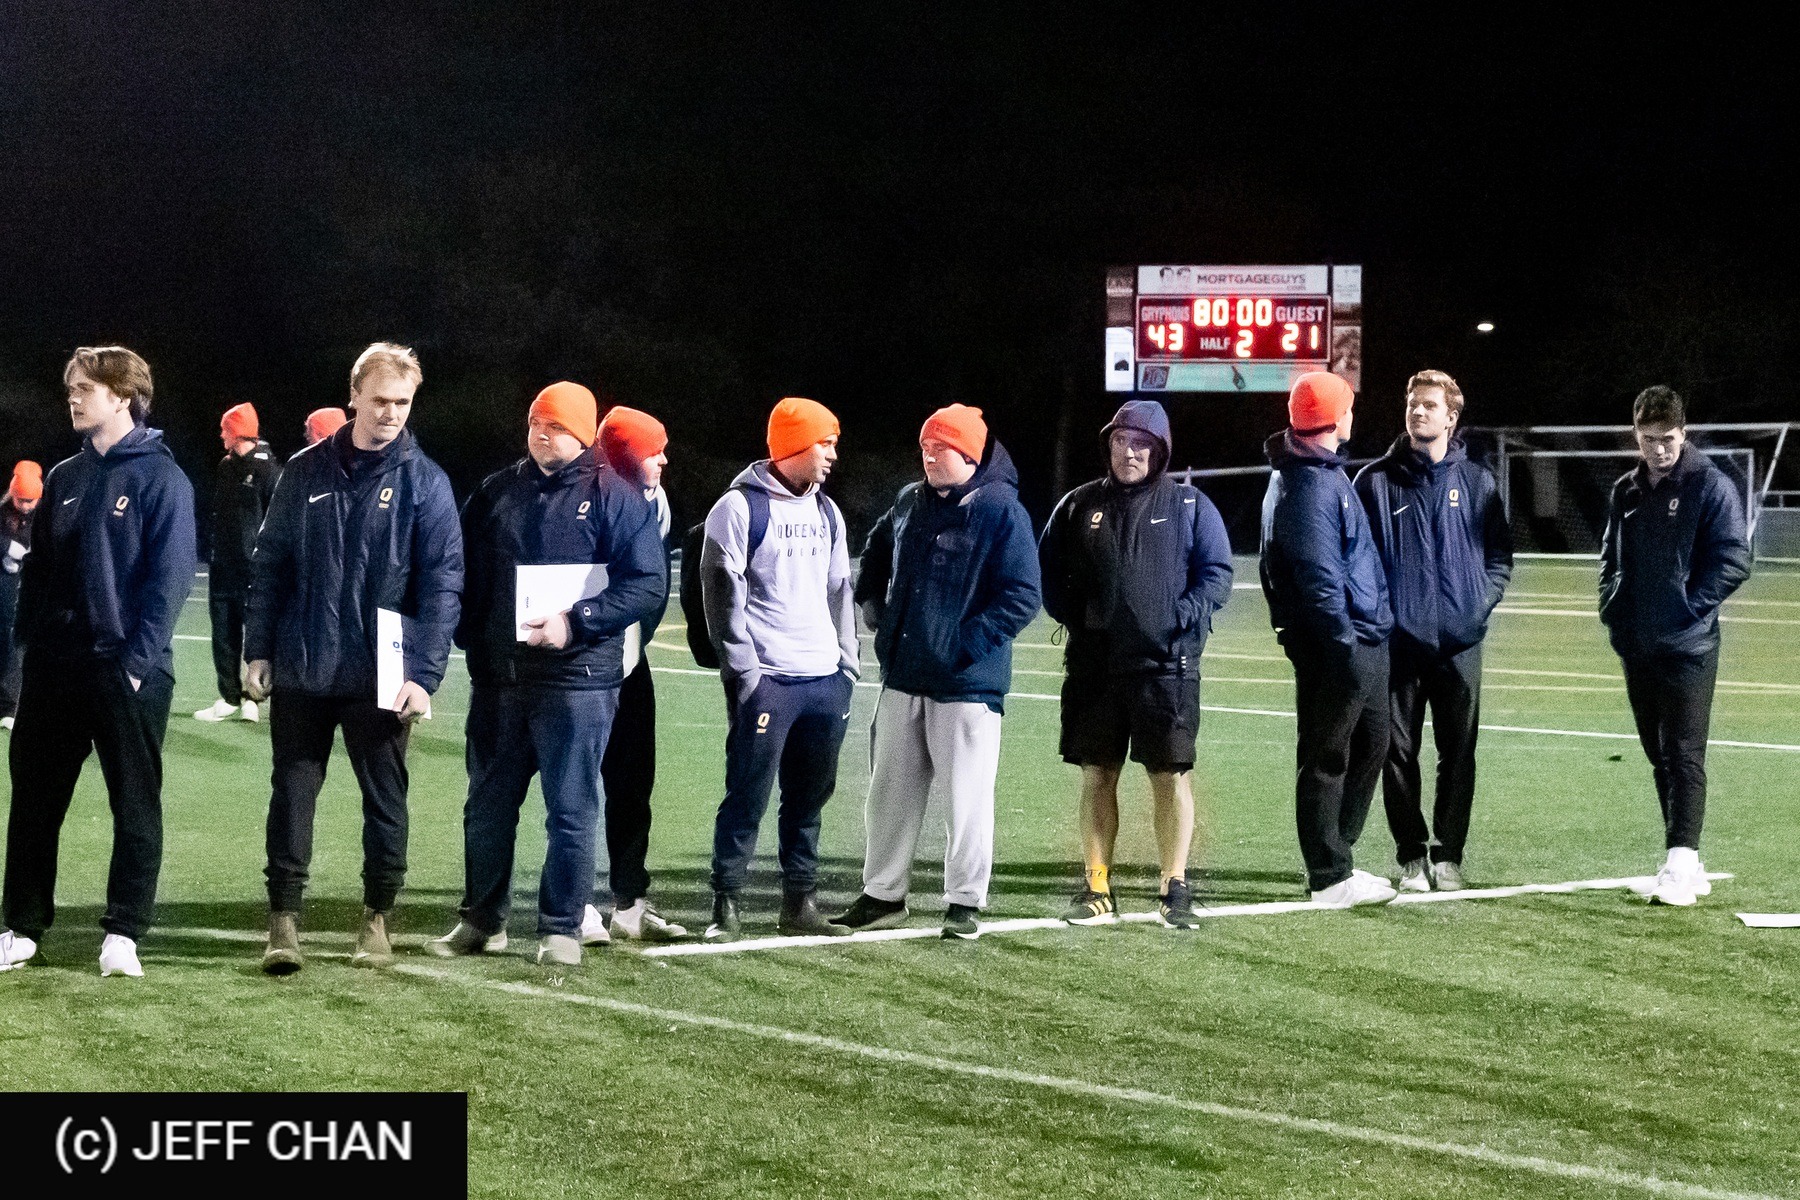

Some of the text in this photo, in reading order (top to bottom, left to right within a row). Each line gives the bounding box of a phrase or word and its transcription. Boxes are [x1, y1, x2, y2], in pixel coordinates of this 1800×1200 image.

[1197, 274, 1306, 284] MORTGAGEGUYS
[1193, 298, 1272, 327] 80:00
[1275, 305, 1325, 322] GUEST
[1148, 322, 1184, 351] 43
[1200, 337, 1231, 350] HALF
[1235, 329, 1254, 358] 2
[1281, 322, 1318, 351] 21
[777, 523, 826, 539] QUEENS
